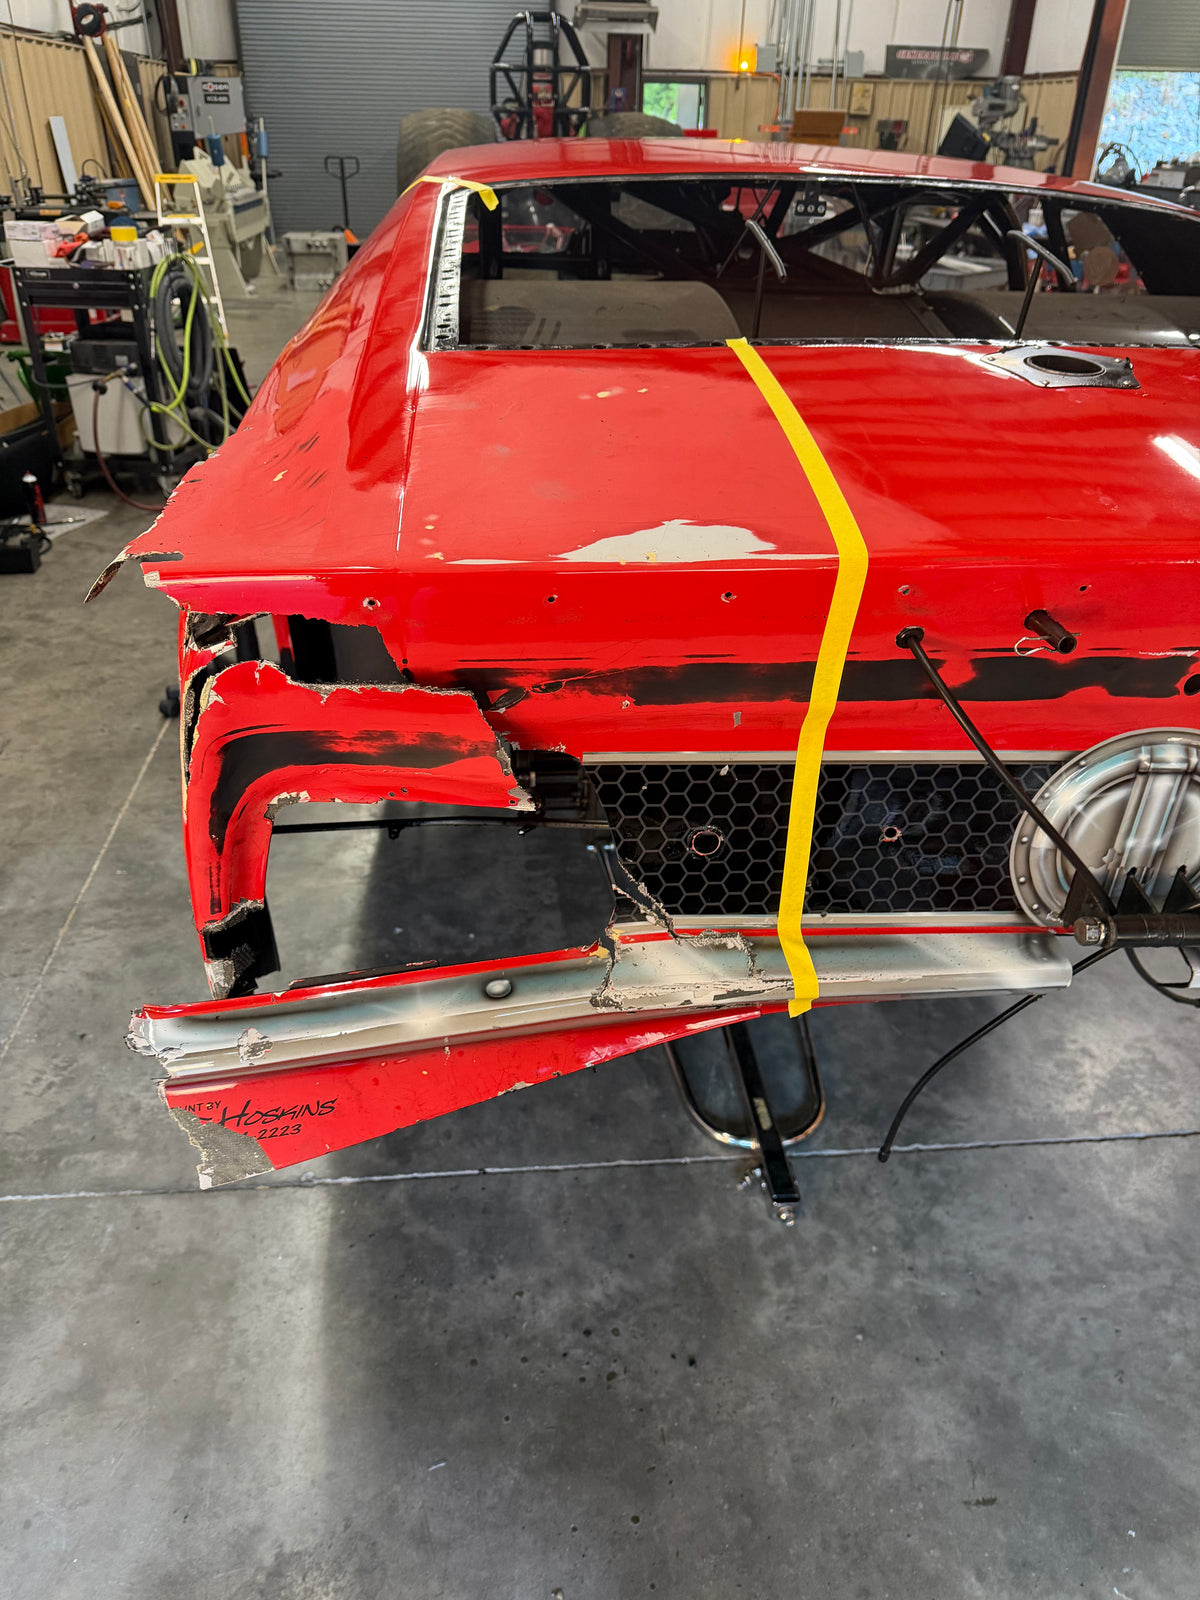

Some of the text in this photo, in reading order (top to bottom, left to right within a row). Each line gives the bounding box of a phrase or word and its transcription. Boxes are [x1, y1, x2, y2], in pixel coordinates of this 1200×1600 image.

[175, 1100, 221, 1112] INT BY
[217, 1098, 337, 1127] HOSKINS
[243, 1124, 302, 1140] 2223
